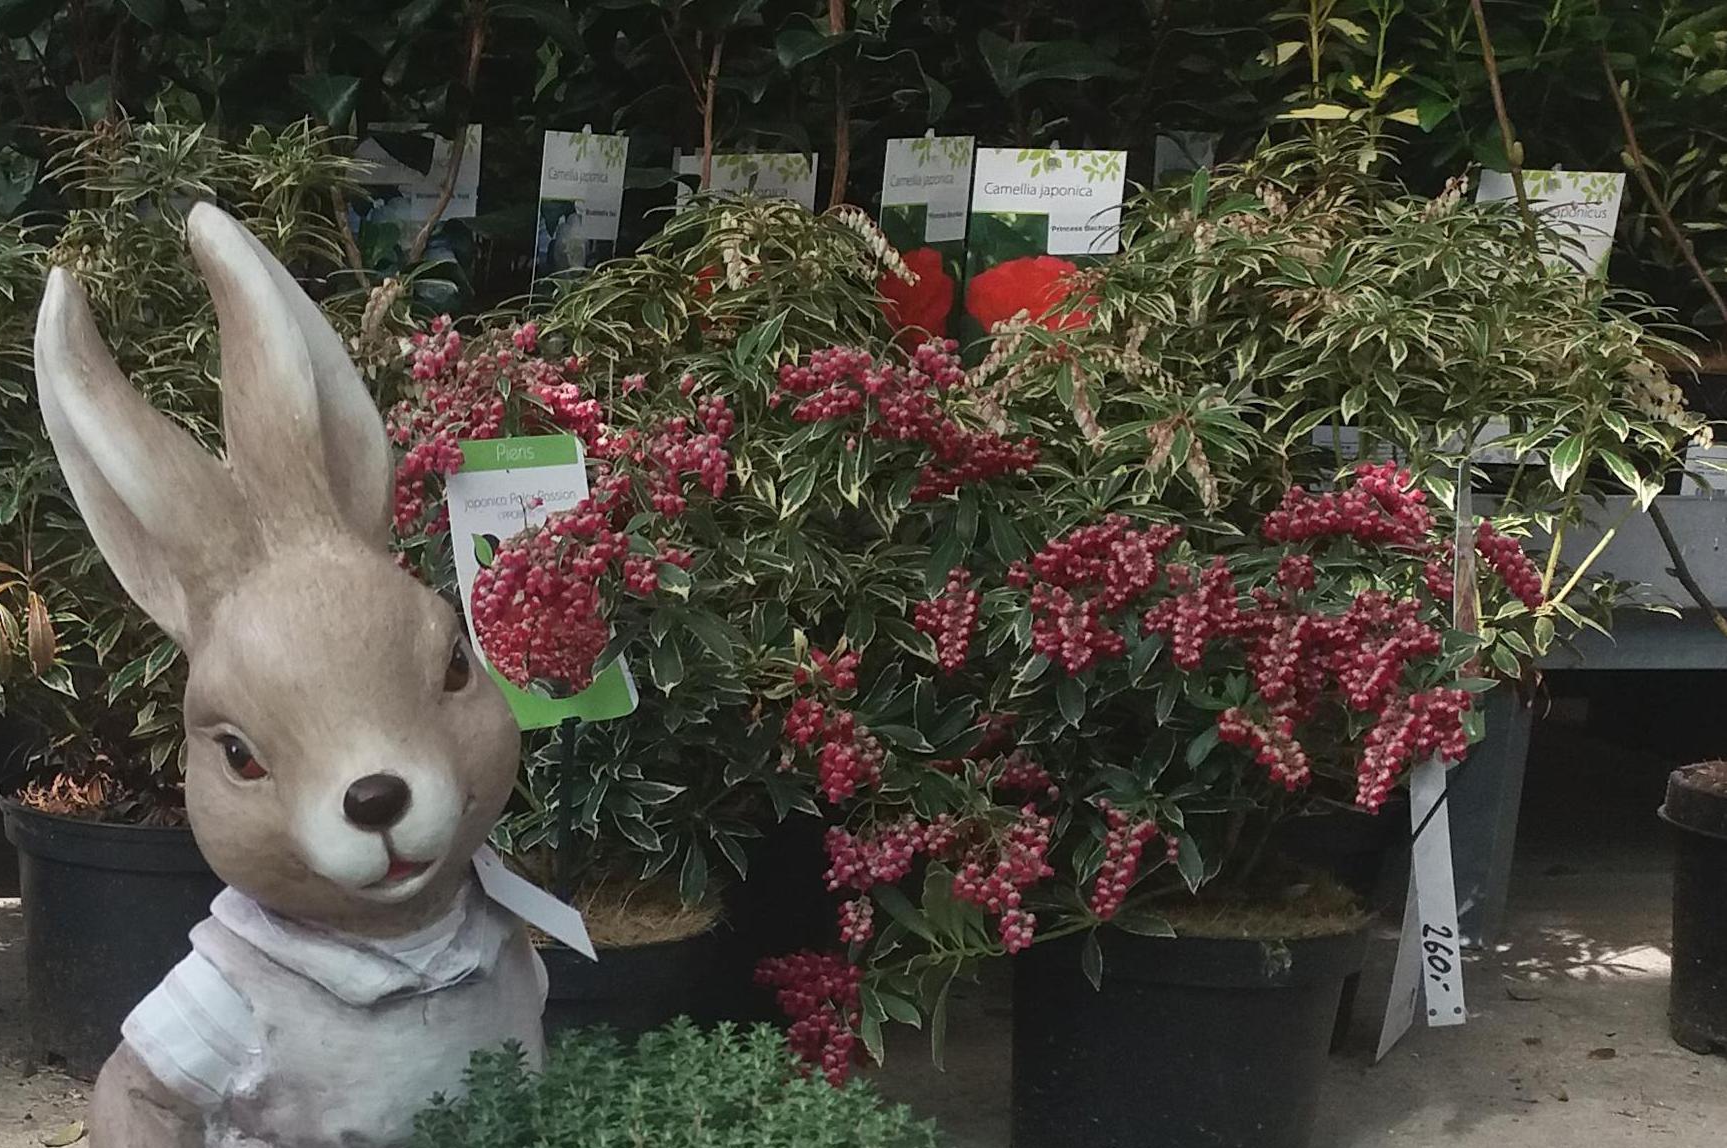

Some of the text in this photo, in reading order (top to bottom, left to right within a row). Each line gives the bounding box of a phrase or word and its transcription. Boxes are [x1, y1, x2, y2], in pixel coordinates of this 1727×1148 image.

[983, 181, 1094, 199] Camellia japonica
[1552, 207, 1608, 220] aponicus
[496, 443, 536, 464] Pieris
[464, 495, 508, 513] japonica
